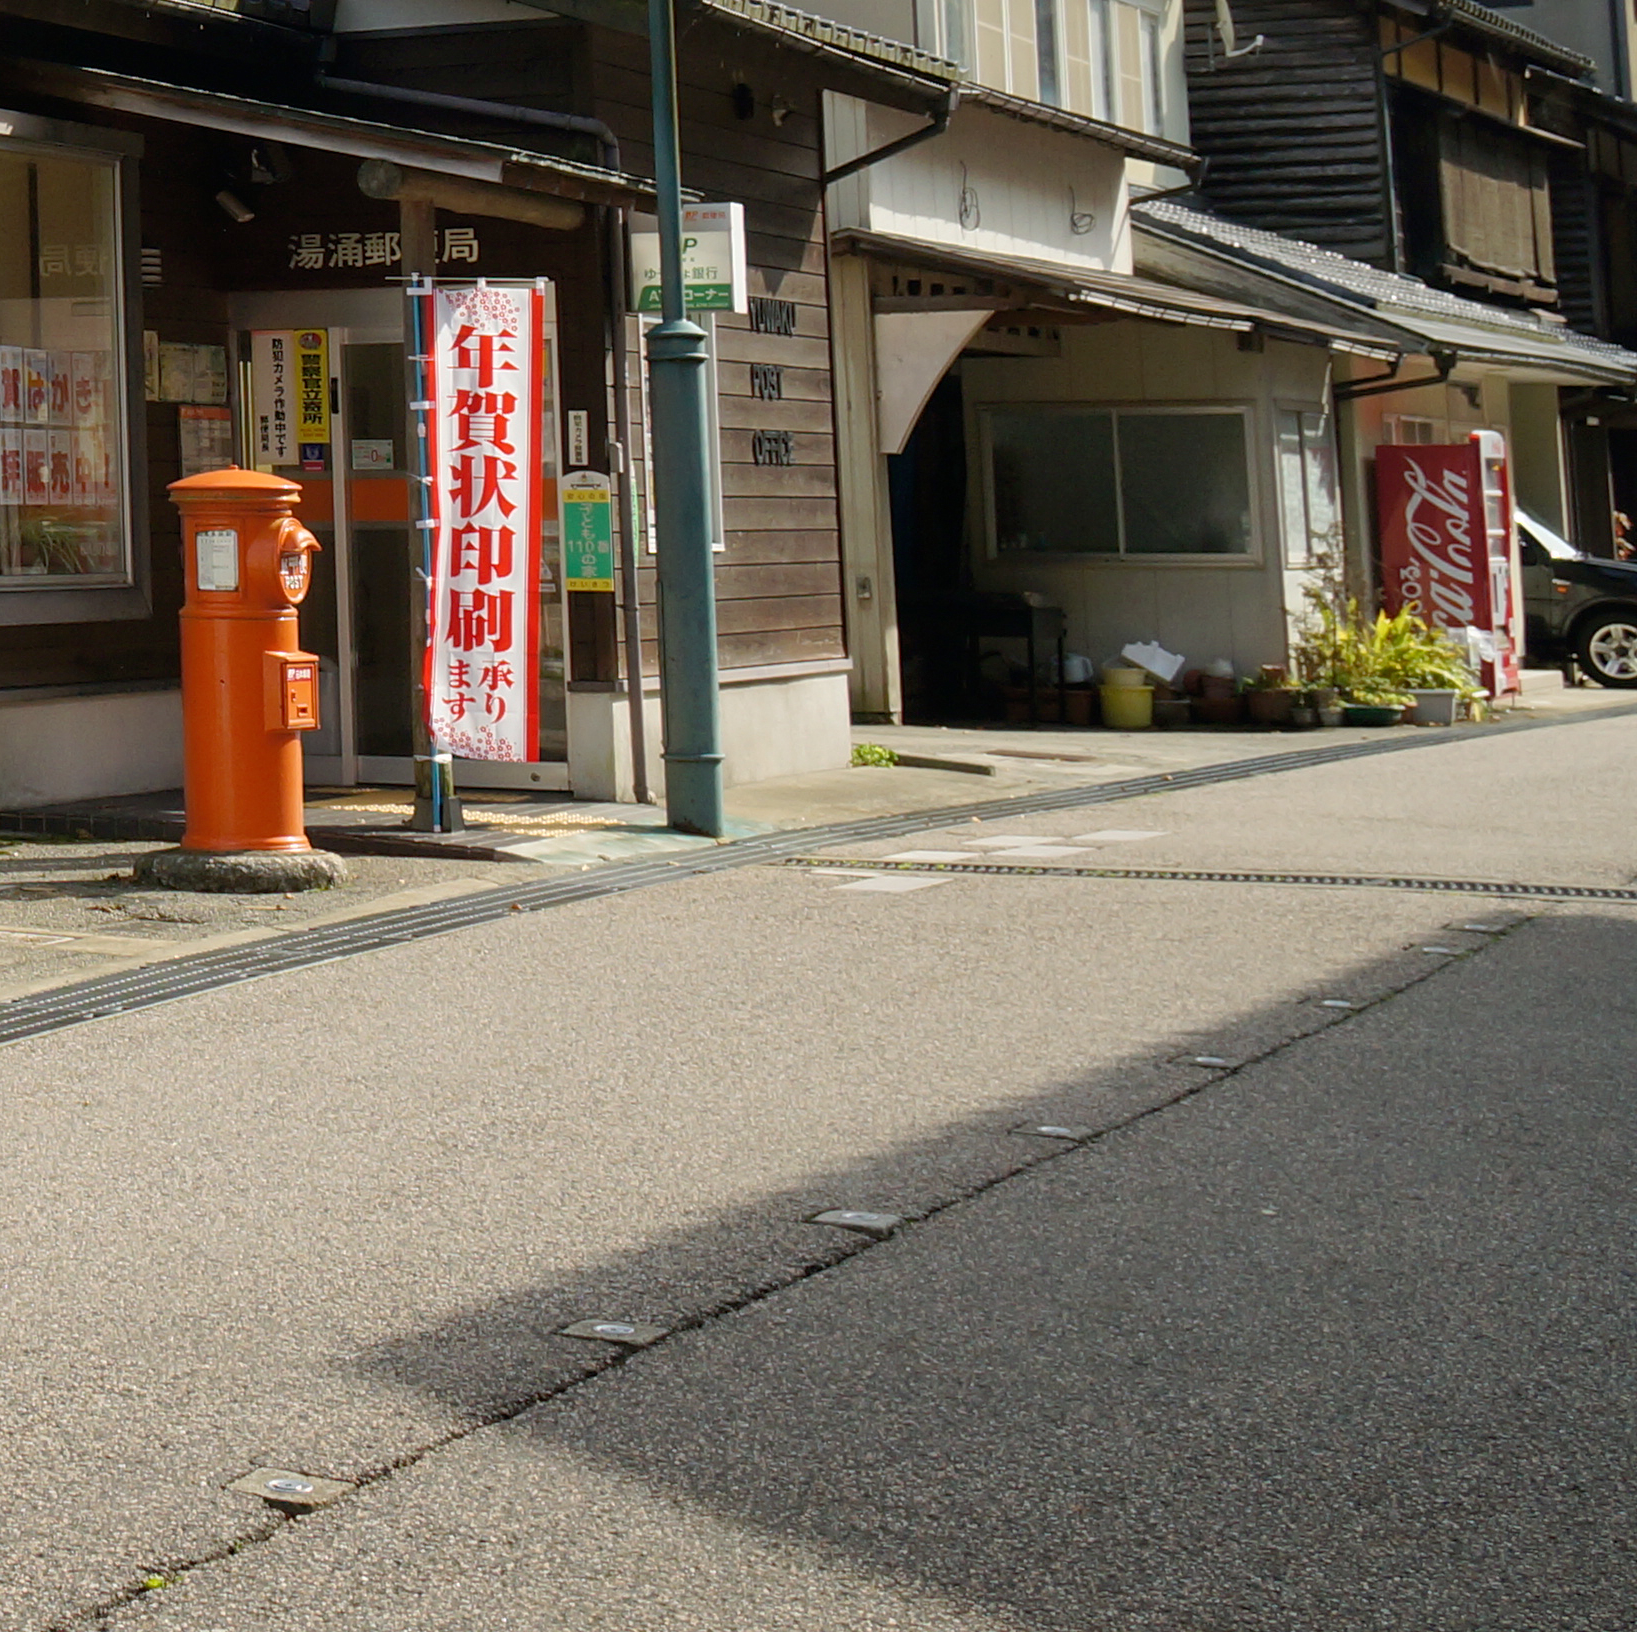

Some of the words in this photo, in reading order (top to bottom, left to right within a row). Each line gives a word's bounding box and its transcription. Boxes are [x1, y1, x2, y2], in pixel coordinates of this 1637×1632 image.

[287, 227, 480, 269] 湯涌郵局
[644, 266, 719, 281] ゆょ銀行
[648, 288, 730, 302] Aコーナー
[748, 297, 797, 337] YUWAKU
[271, 337, 287, 458] 防犯カメラ作動中です
[751, 363, 784, 401] POST
[753, 429, 794, 466] OFFICE
[443, 324, 521, 653] 年賀状印刷
[1404, 455, 1474, 628] ca-Cola
[442, 658, 477, 724] ます
[476, 659, 516, 725] 承り
